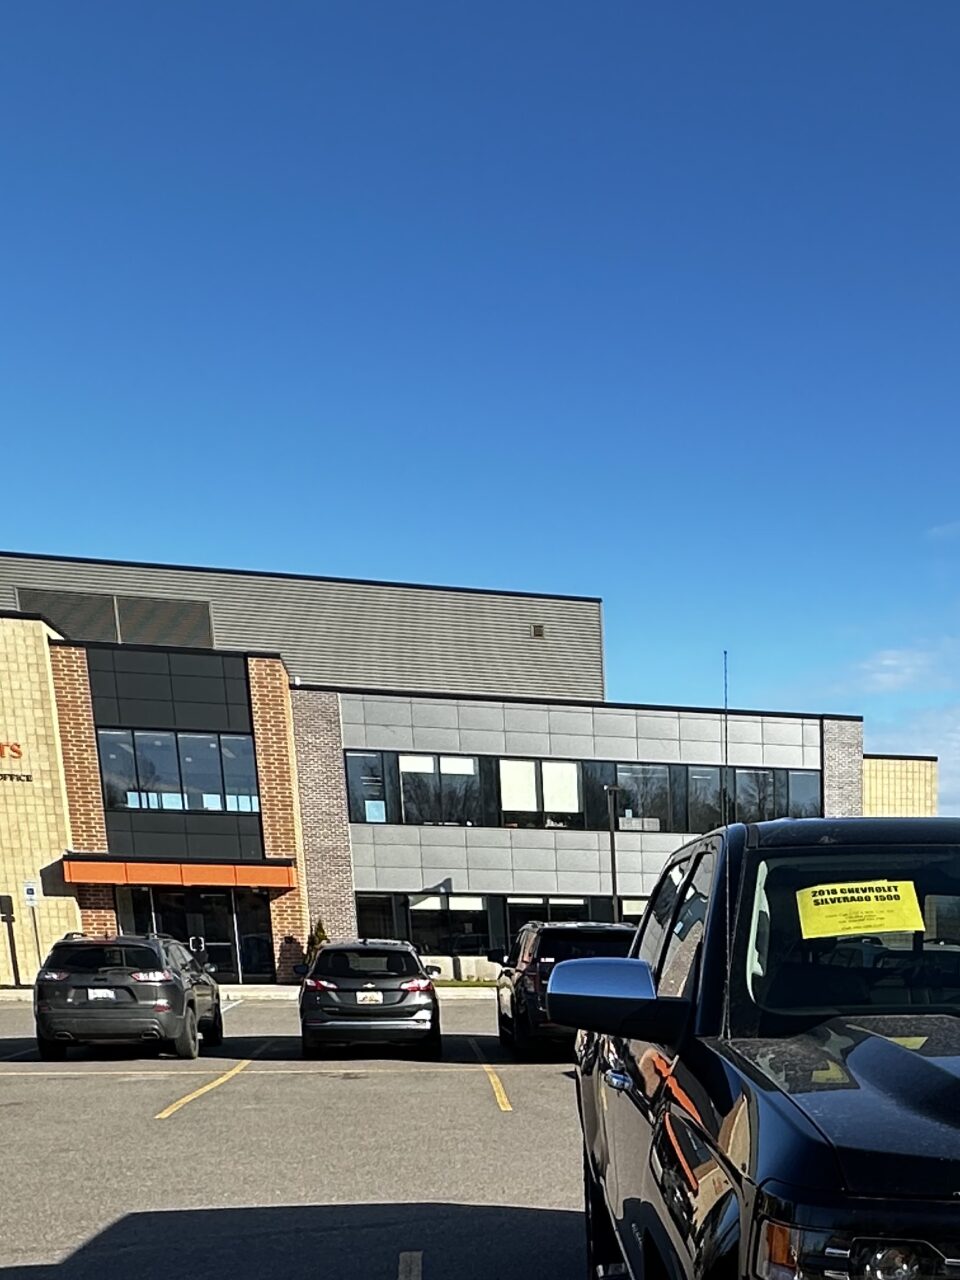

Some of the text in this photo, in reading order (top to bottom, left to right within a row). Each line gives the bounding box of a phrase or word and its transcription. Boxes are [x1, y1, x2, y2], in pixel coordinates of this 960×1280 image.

[811, 886, 899, 897] 2018 CHEVROLET
[813, 895, 872, 906] SILVERADO
